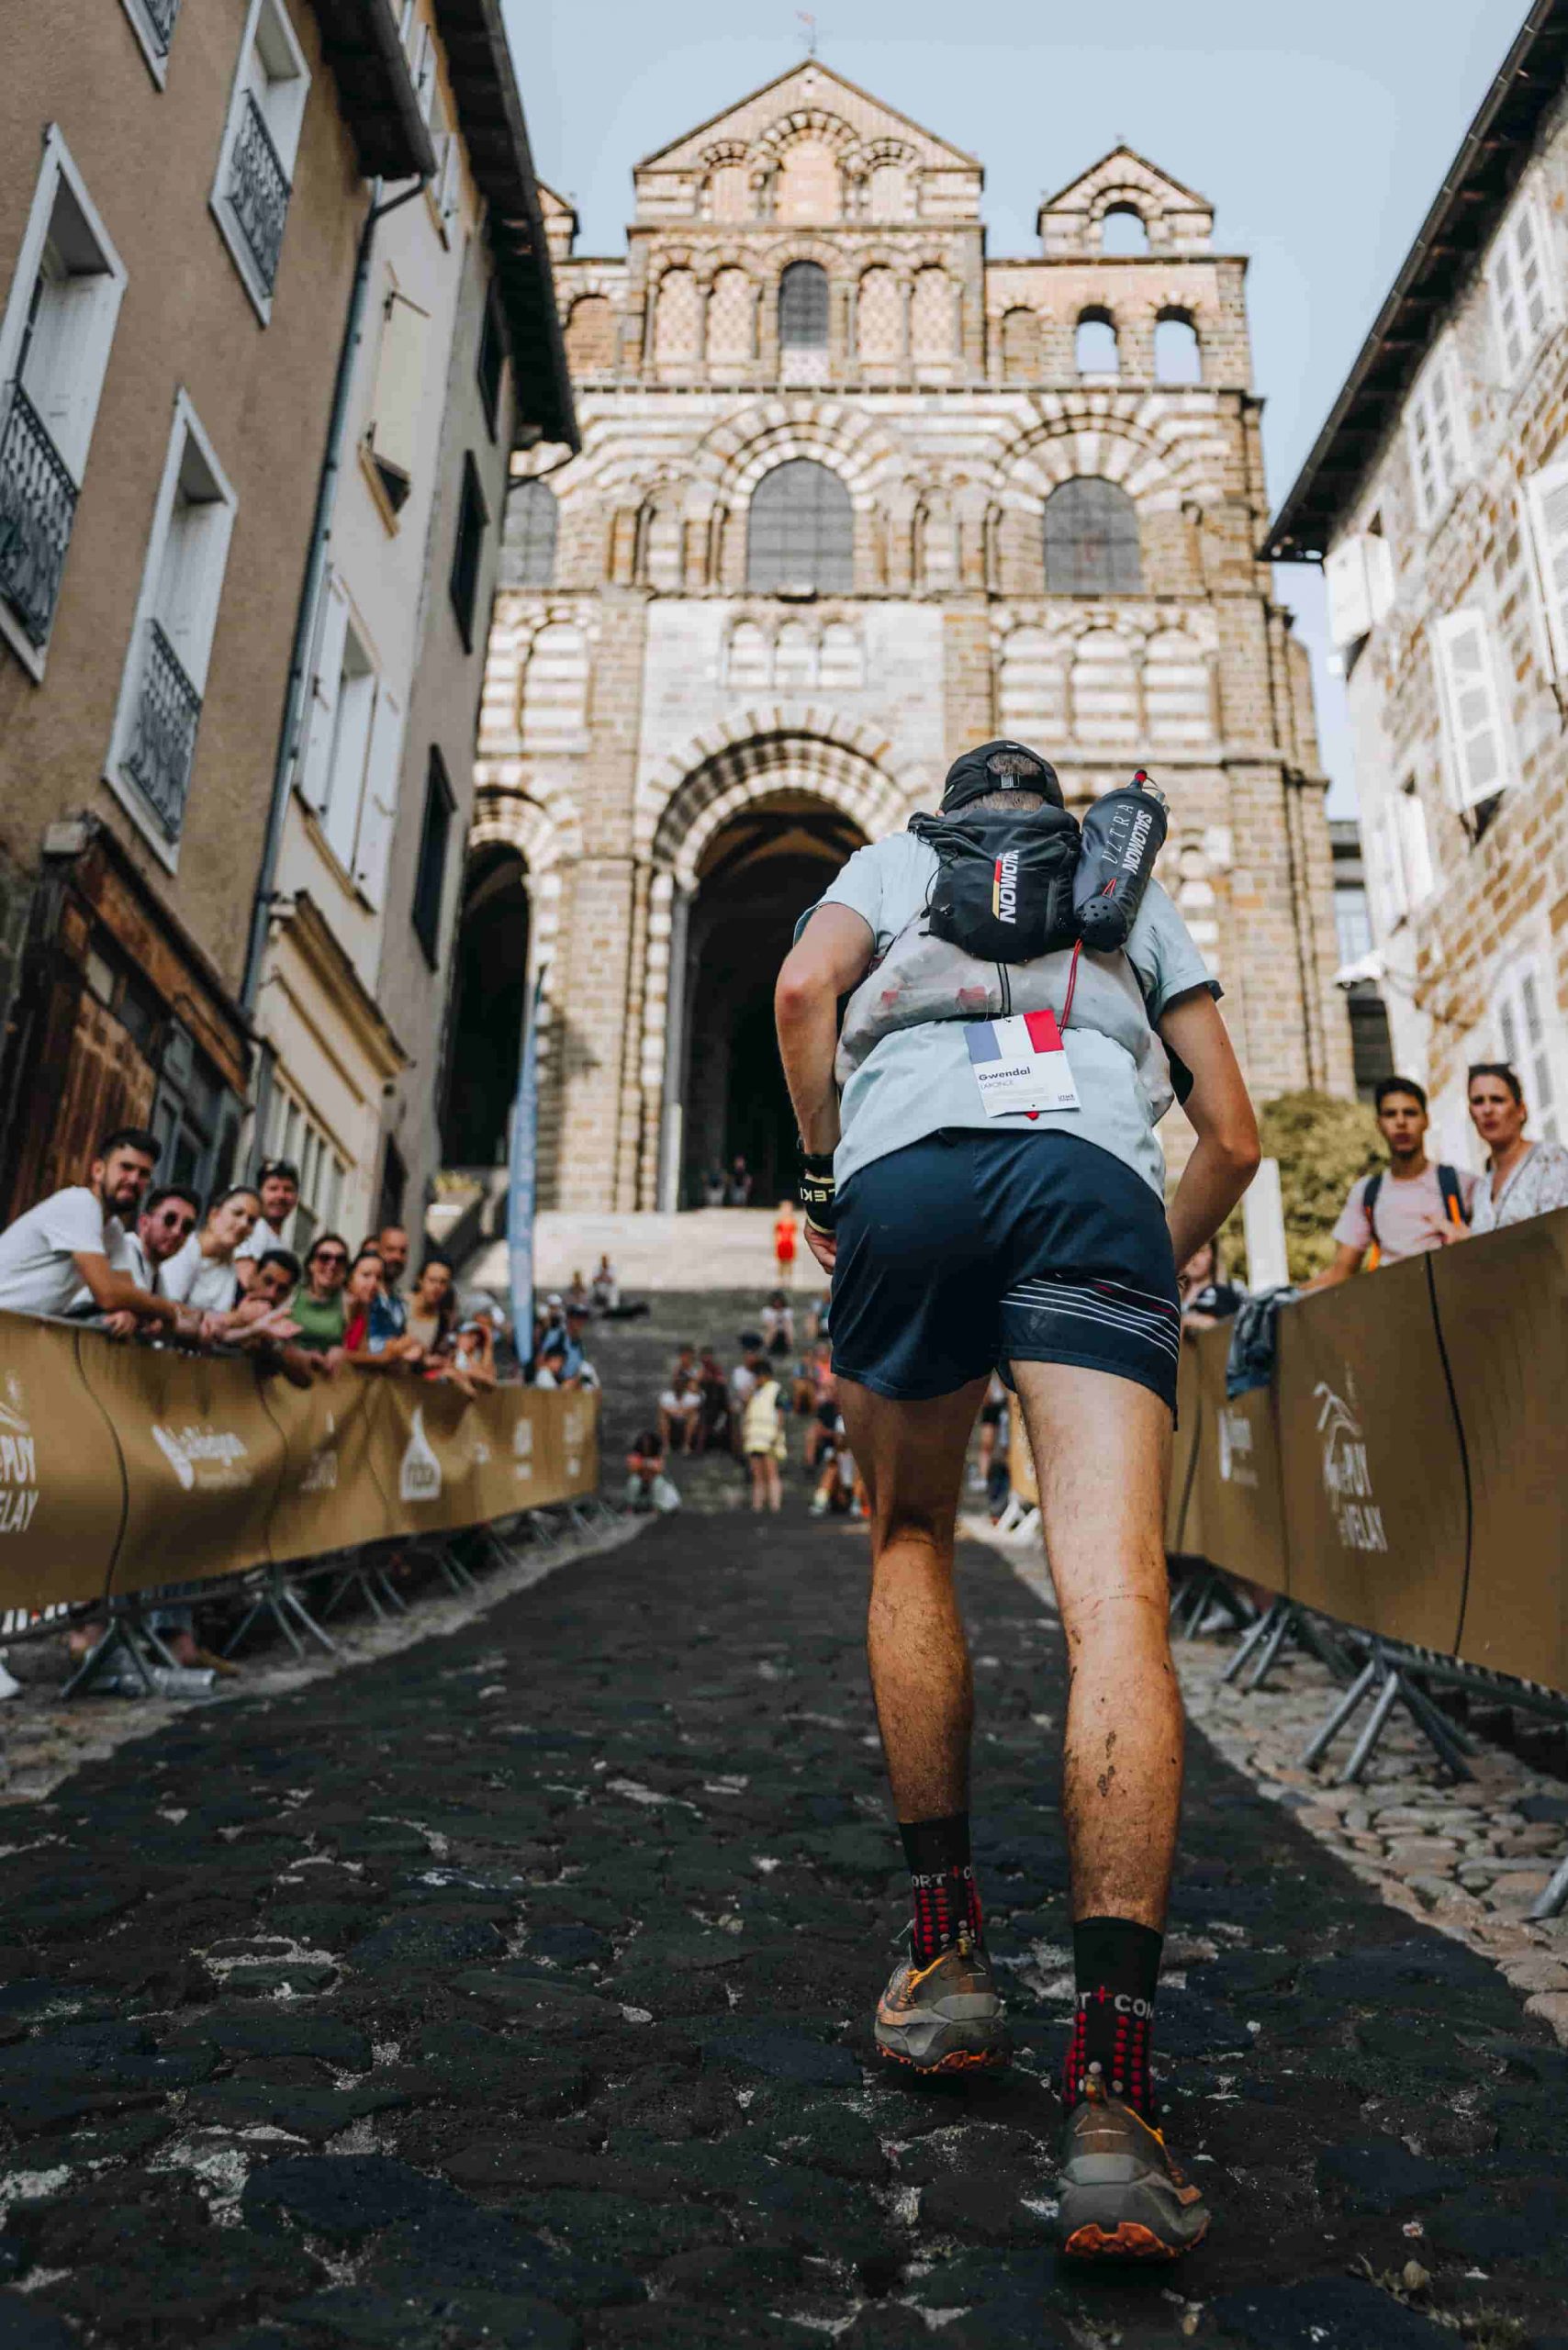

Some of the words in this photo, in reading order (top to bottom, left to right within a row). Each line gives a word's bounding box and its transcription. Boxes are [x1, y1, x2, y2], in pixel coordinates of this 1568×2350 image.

[1122, 810, 1153, 875] SALOMON
[1000, 850, 1019, 923] ALOMON
[979, 1066, 1031, 1080] Gwendal
[1, 1436, 36, 1483] PUY
